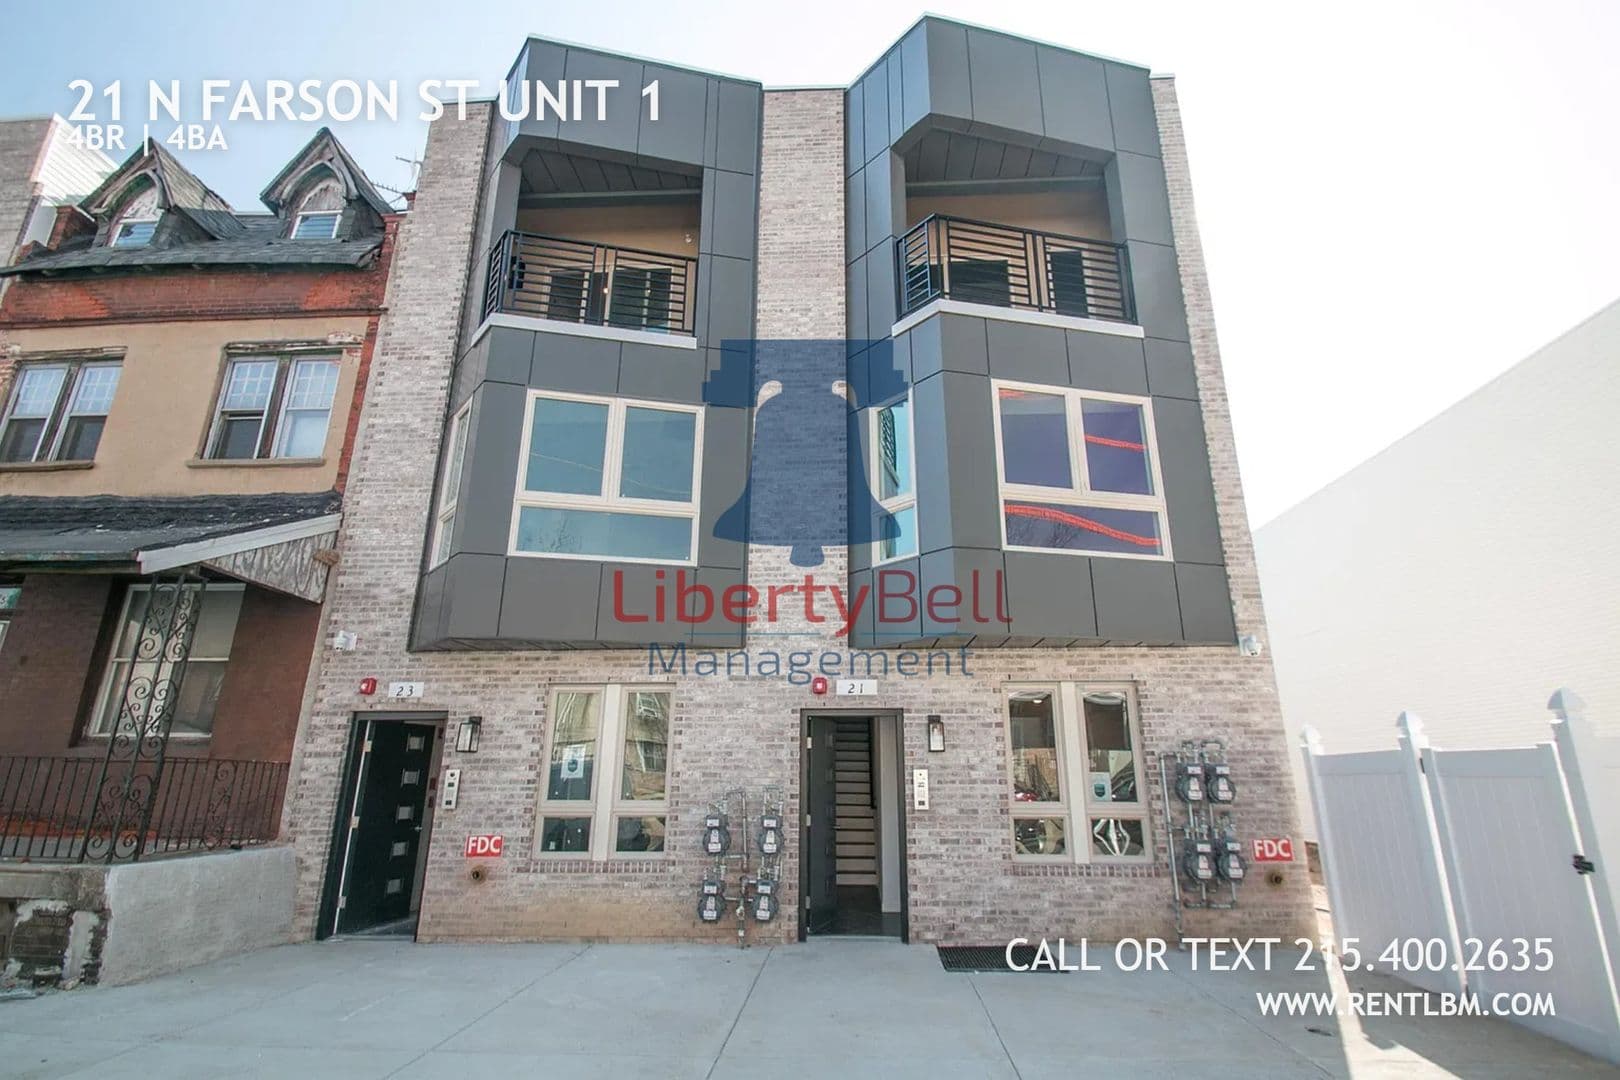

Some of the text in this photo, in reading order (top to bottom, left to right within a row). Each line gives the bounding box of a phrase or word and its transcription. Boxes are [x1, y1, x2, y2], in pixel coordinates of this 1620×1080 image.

[396, 685, 414, 697] 23
[848, 683, 864, 694] 21
[468, 837, 502, 855] FDC
[1254, 840, 1292, 858] FDC
